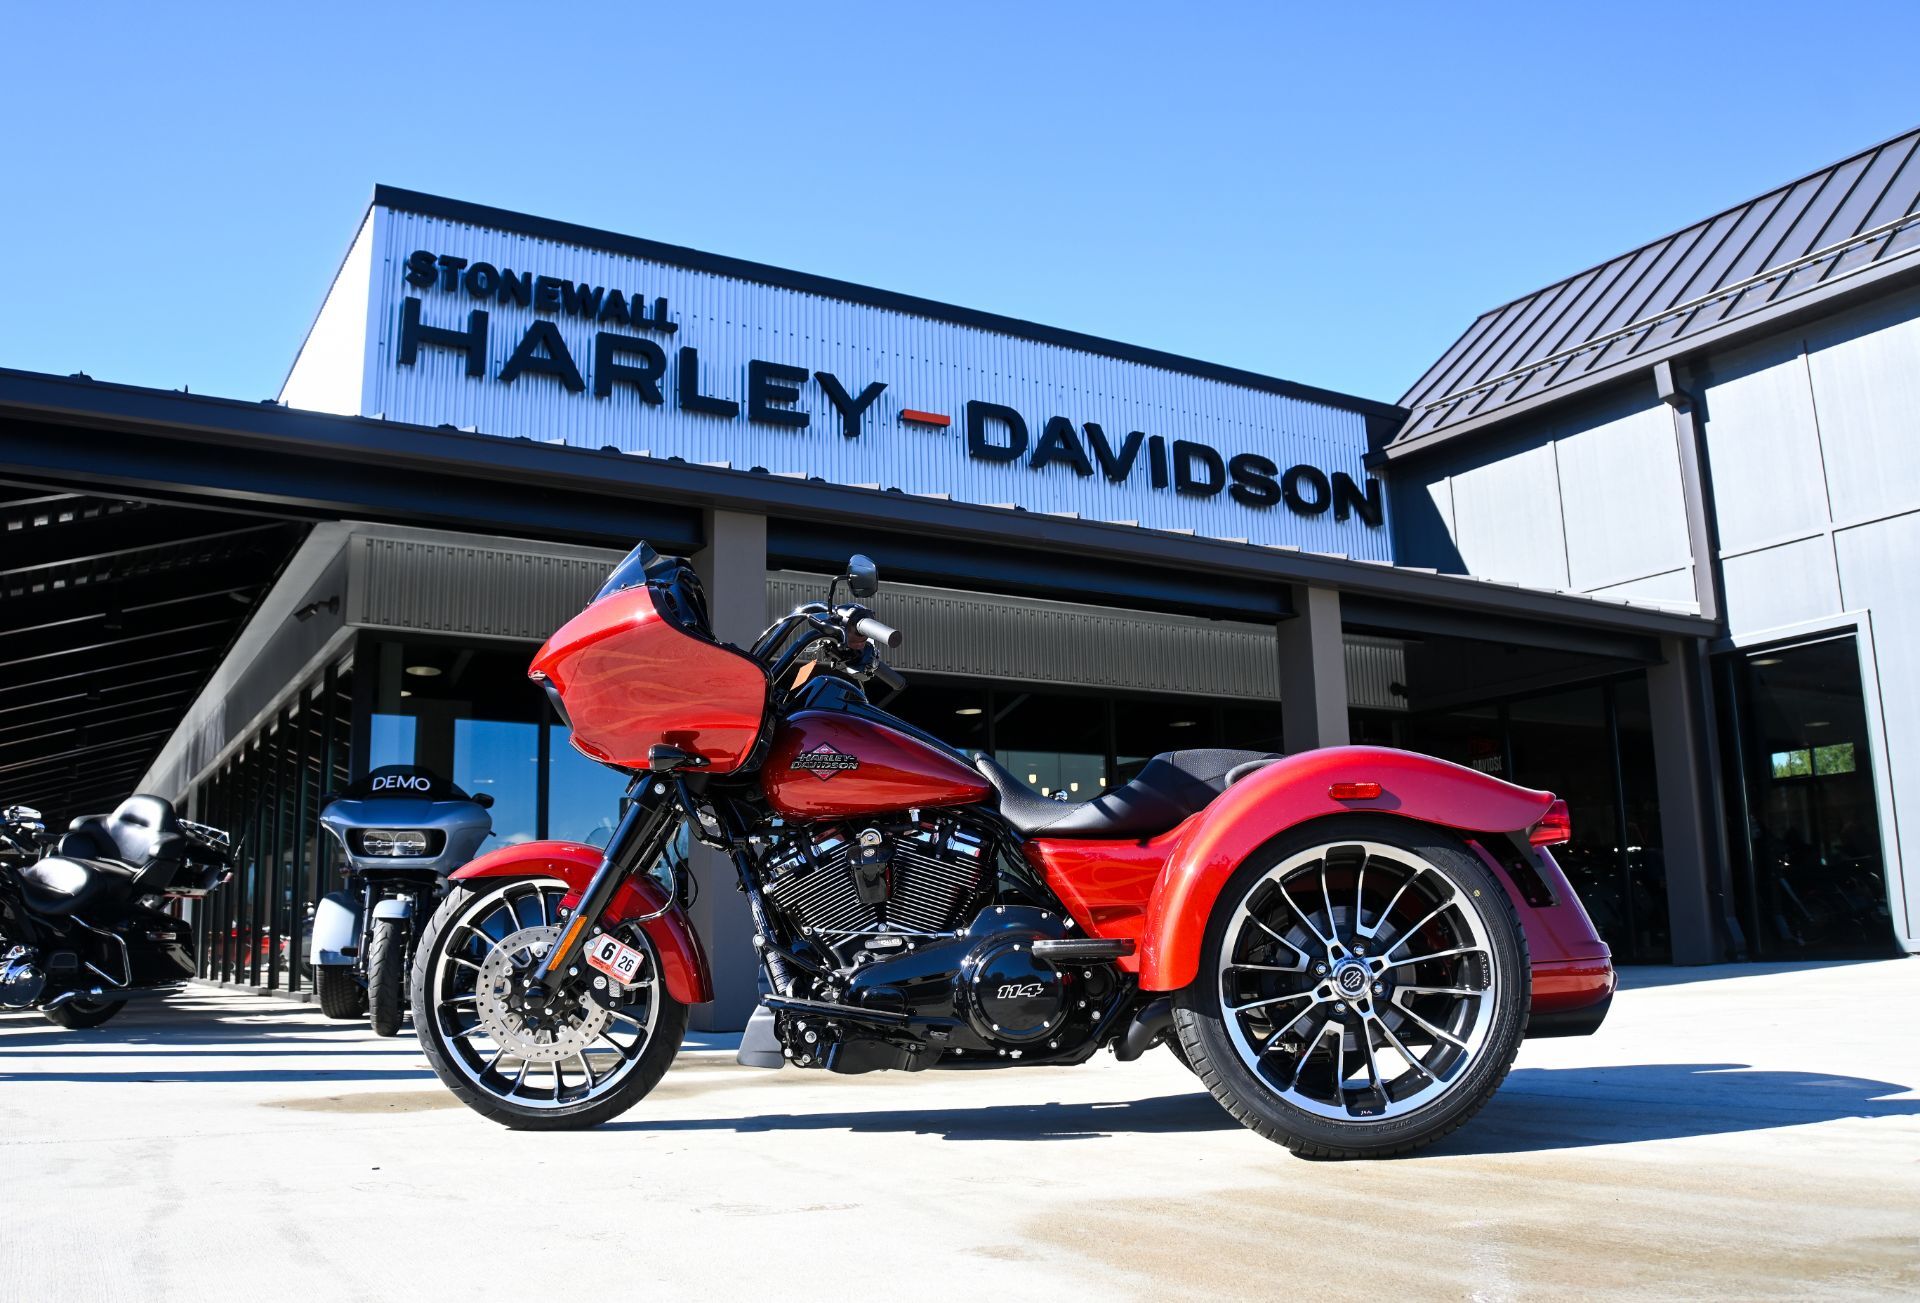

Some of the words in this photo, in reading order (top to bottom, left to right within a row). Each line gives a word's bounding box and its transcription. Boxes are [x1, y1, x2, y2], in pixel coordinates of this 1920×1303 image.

[405, 249, 679, 333] STONEWALL
[790, 761, 859, 770] DAVIDSON
[371, 775, 431, 791] DEMO
[601, 942, 617, 961] 6
[617, 955, 635, 972] 26
[996, 983, 1045, 999] 114
